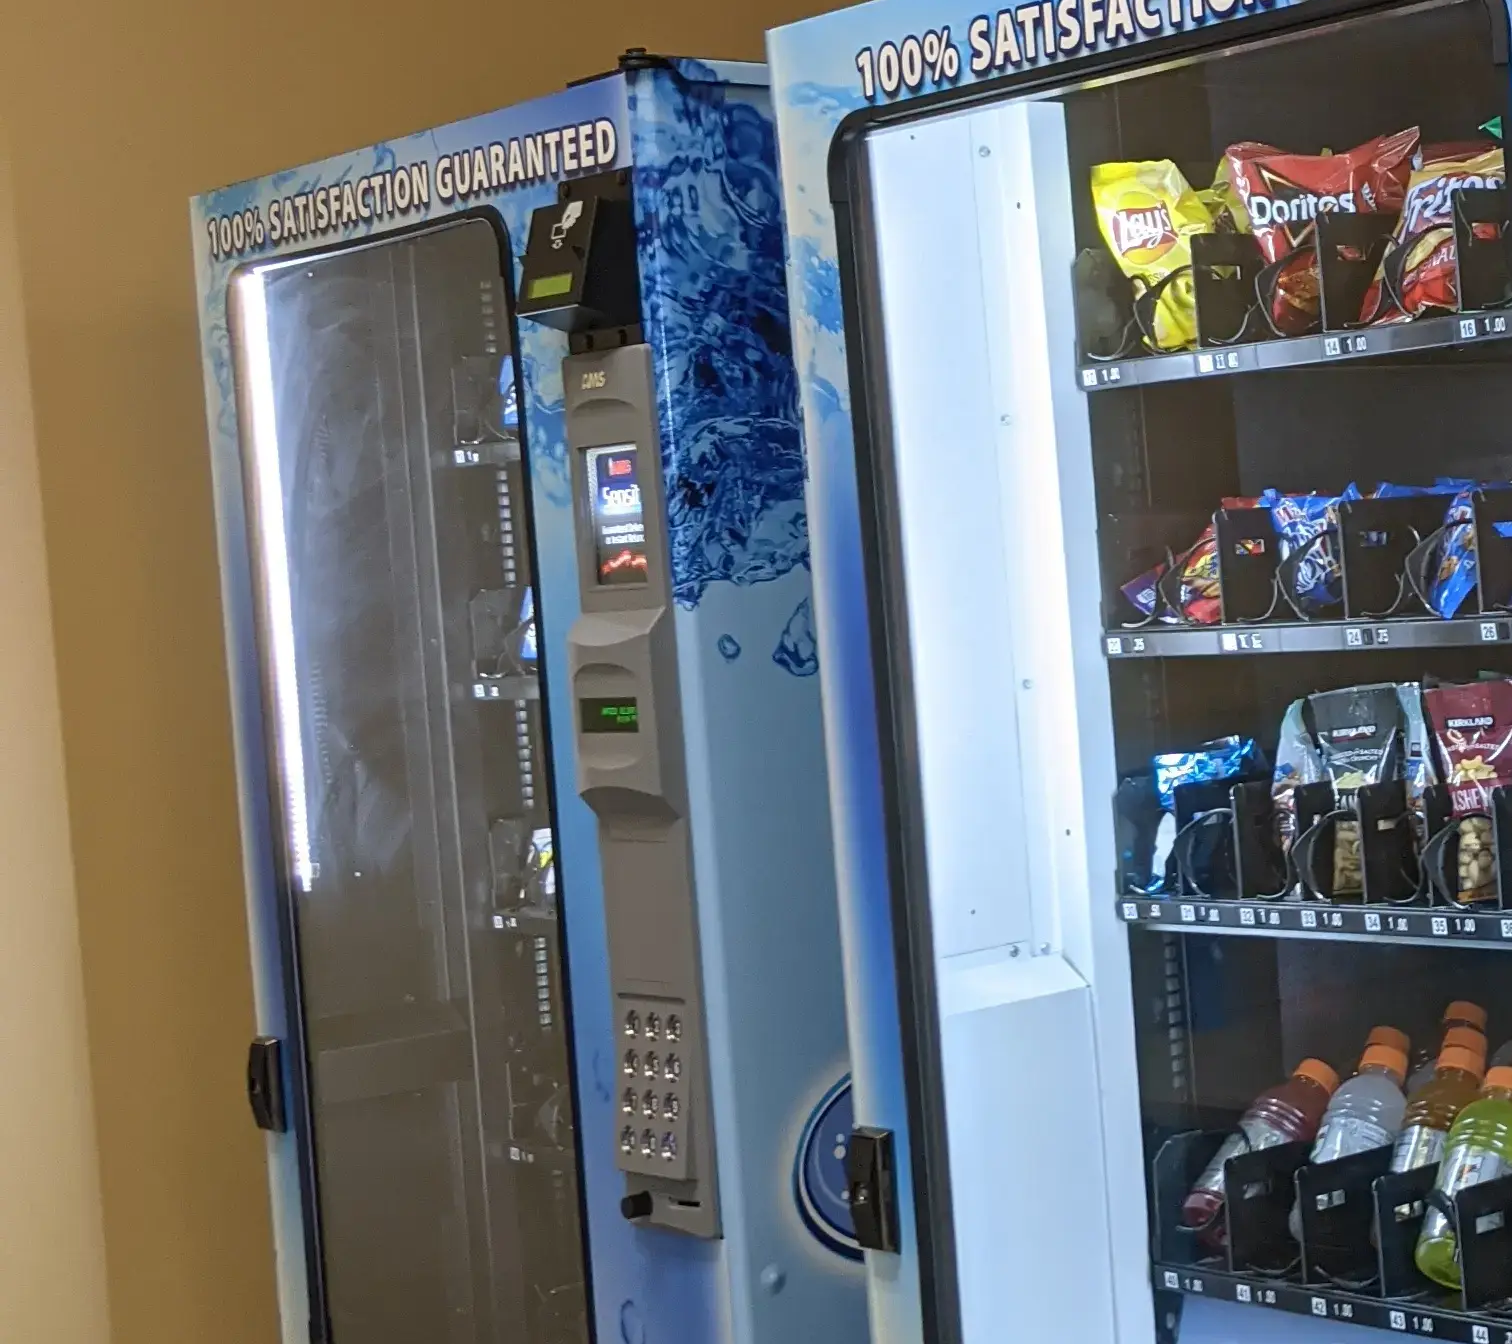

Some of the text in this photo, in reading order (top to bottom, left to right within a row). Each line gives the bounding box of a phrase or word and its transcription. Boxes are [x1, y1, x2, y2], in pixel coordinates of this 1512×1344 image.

[857, 26, 960, 100] 100%
[208, 119, 618, 257] 100% SATISFACTION GUARANTEED
[1250, 192, 1357, 226] Doritos
[1112, 202, 1174, 252] Lay's
[1462, 321, 1476, 336] 16
